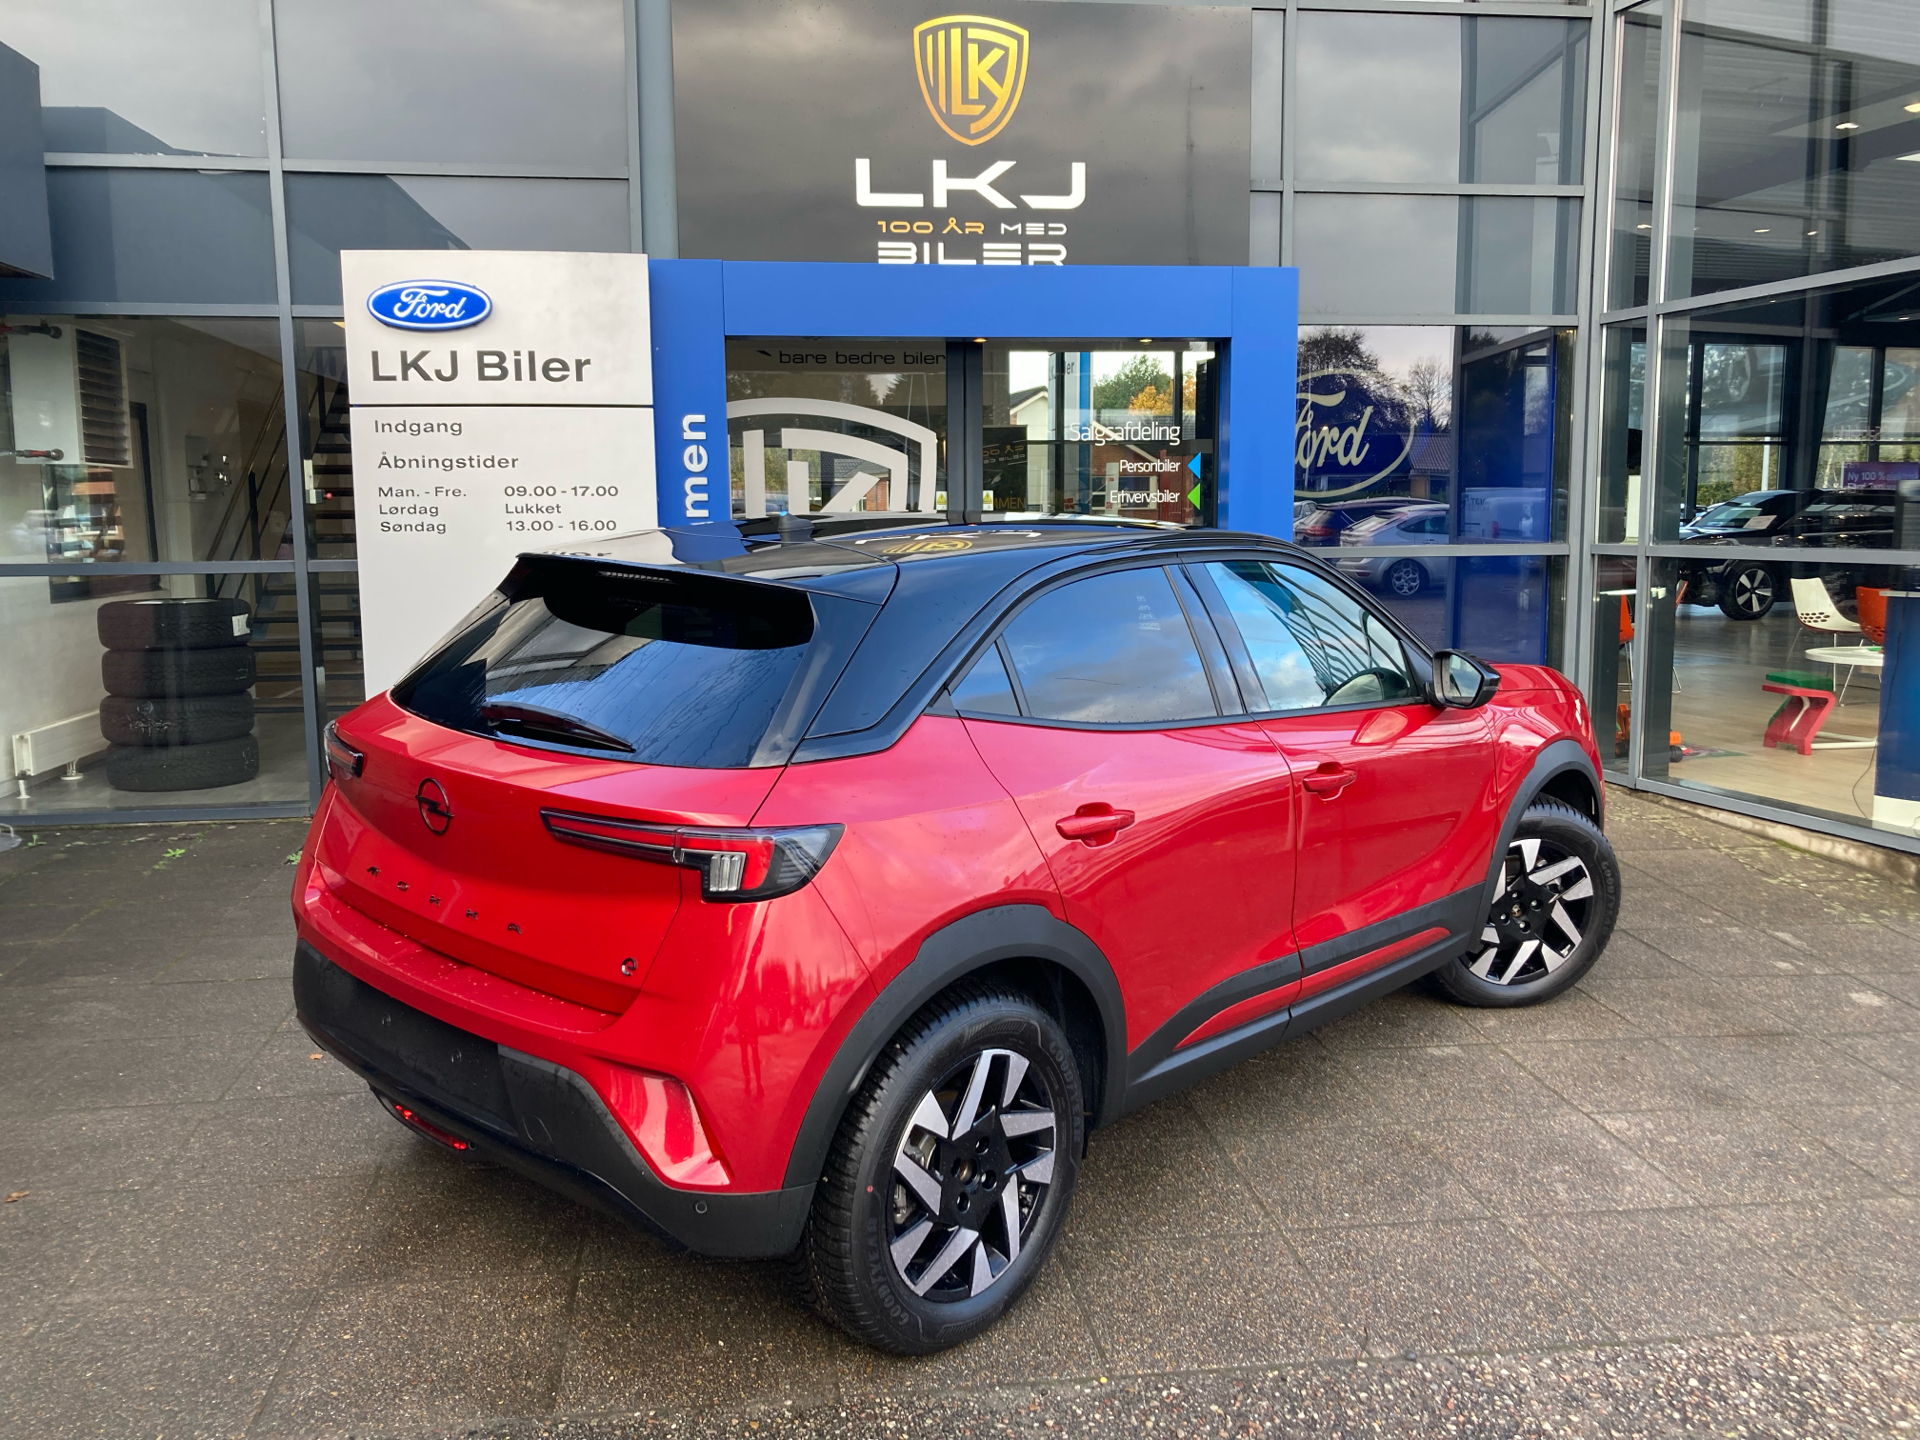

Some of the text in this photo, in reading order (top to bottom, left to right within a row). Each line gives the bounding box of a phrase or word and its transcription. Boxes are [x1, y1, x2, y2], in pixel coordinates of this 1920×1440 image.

[855, 158, 1086, 210] LKJ
[877, 217, 1067, 235] 100 ÅR MED
[878, 241, 1067, 266] BILER
[393, 287, 468, 319] Ford
[779, 350, 947, 365] bare bedre biler
[371, 350, 591, 382] LKJ Biler
[374, 420, 463, 436] Indgang
[1069, 421, 1180, 446] Salgsafdeling
[377, 451, 519, 472] Åbningstider
[1119, 458, 1180, 473] Personbiler
[682, 413, 709, 526] men
[1862, 471, 1876, 481] 100
[378, 486, 421, 497] Man.
[434, 486, 467, 497] Fre.
[504, 485, 557, 497] 09.00
[570, 485, 619, 497] 17.00
[1110, 489, 1180, 504] Erhvervsbiler
[379, 504, 439, 518] Lørdag
[505, 503, 562, 514] Lukket
[380, 521, 447, 535] Søndag
[506, 520, 554, 532] 13.00
[569, 519, 617, 532] 16.00
[367, 866, 523, 935] MOKKA
